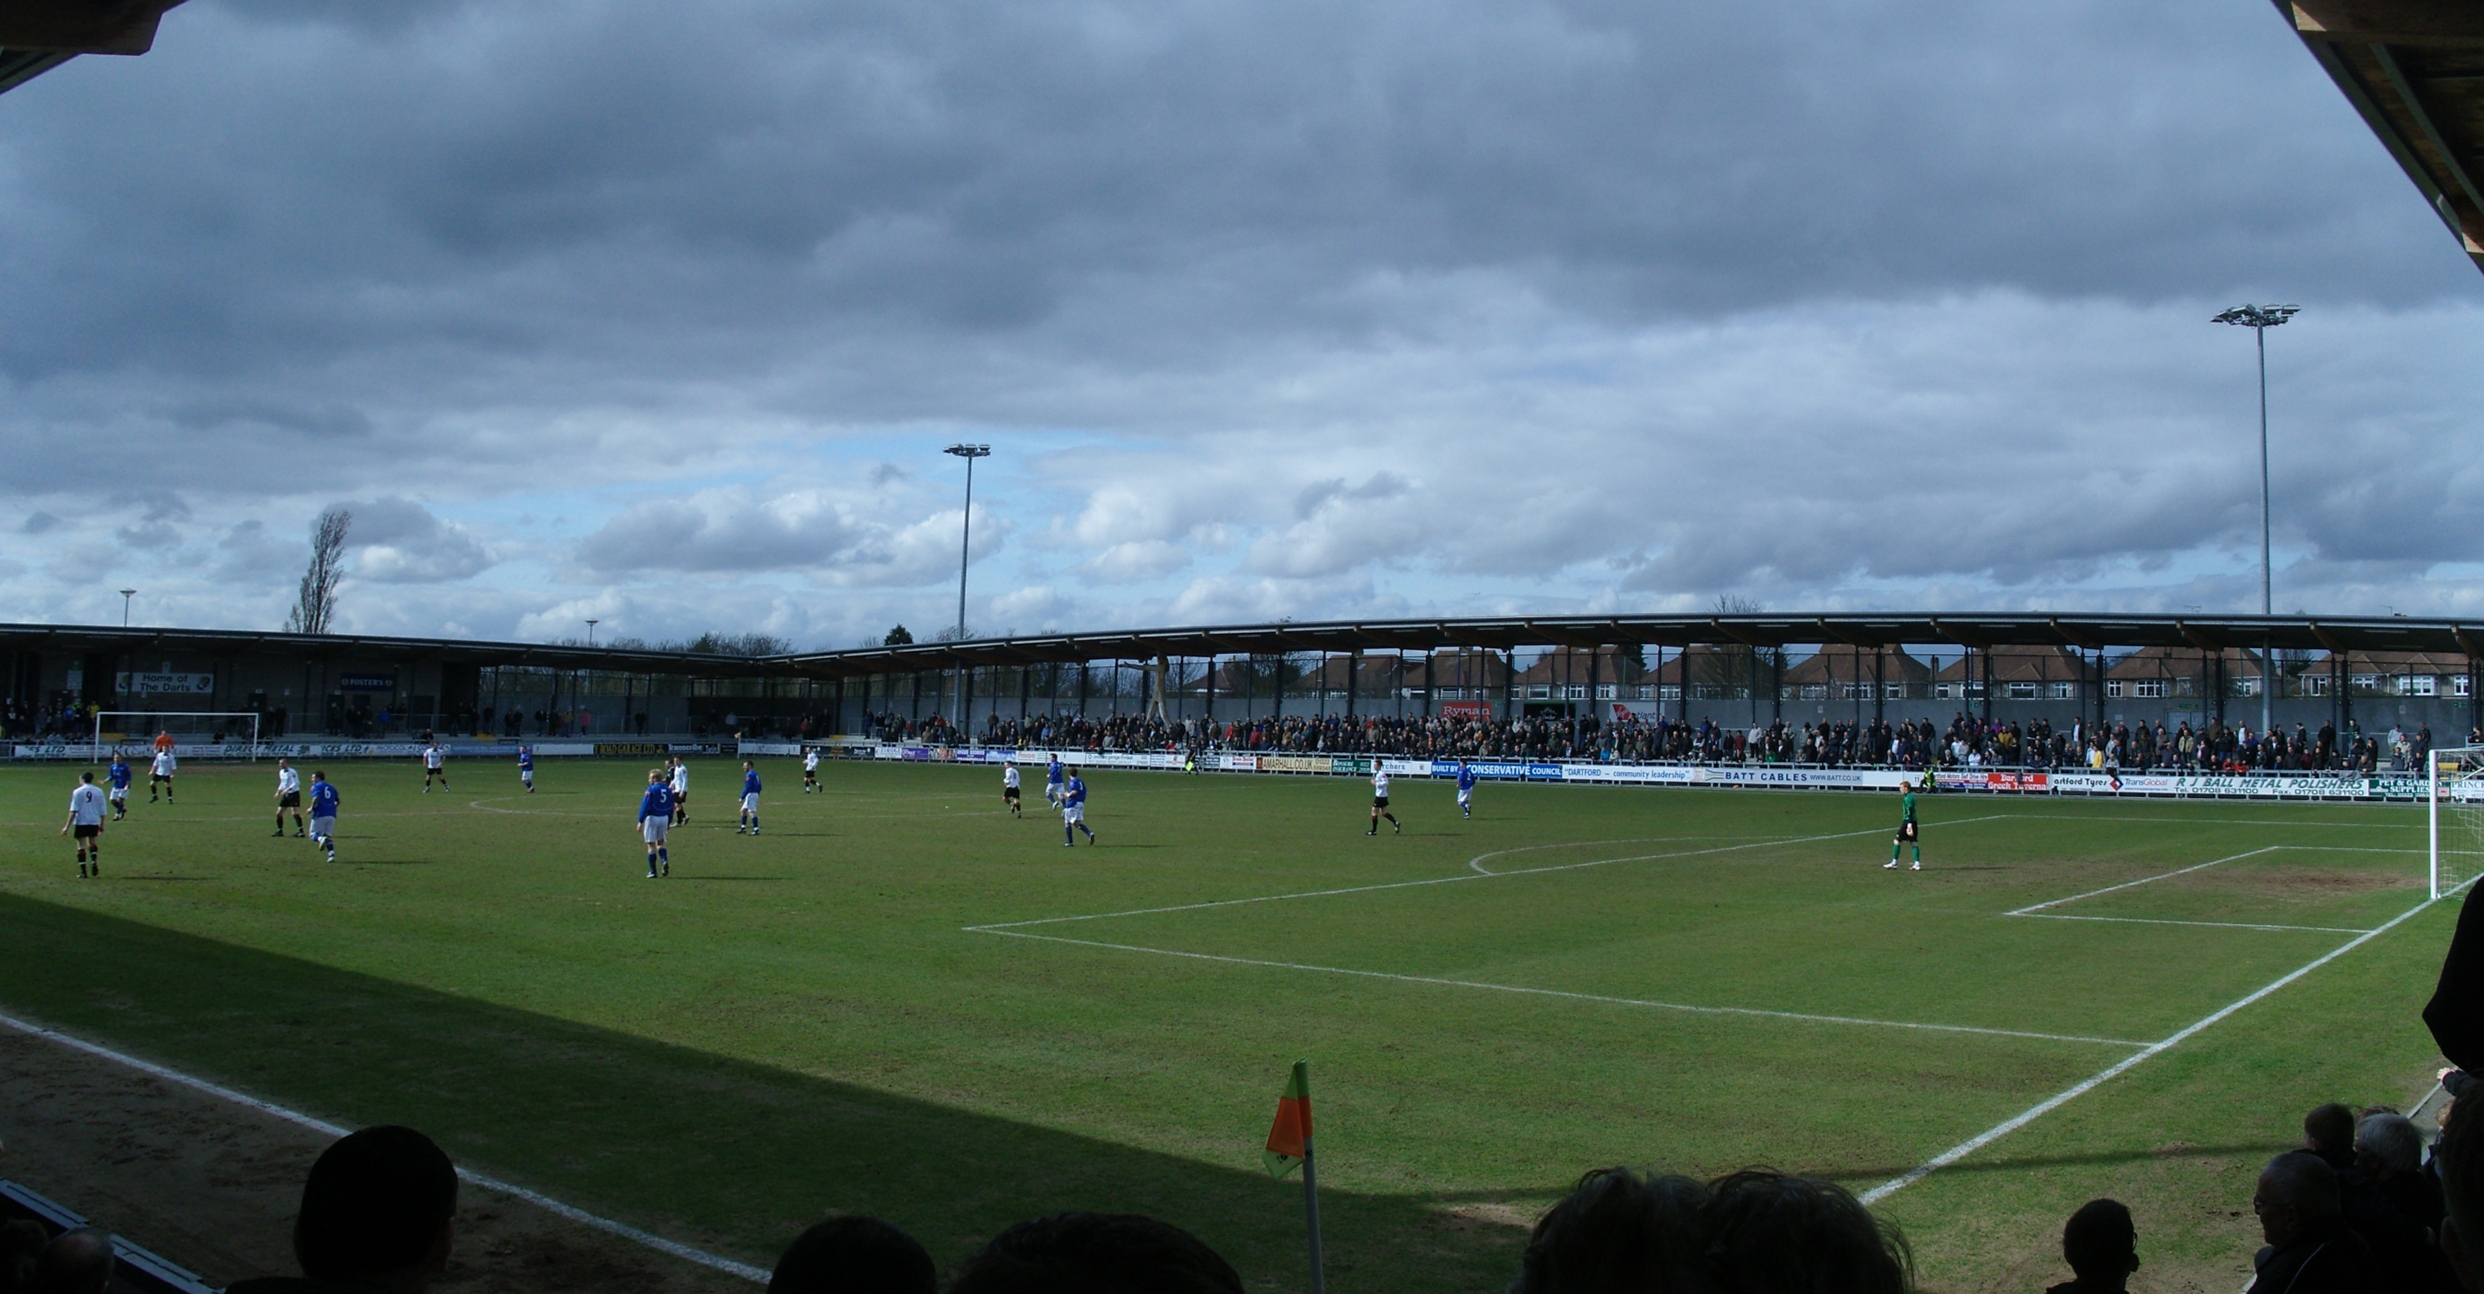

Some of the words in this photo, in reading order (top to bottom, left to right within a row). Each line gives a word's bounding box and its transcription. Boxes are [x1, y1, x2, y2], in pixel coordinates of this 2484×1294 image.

[143, 674, 173, 682] Home
[177, 674, 188, 682] of
[350, 678, 384, 686] FOSTER'S
[140, 683, 158, 691] The
[162, 683, 191, 692] Darts
[1443, 706, 1490, 716] Ryman
[1432, 764, 1450, 773] BUILT
[1450, 764, 1459, 773] BY
[1466, 764, 1531, 775] CONSERVATIVE
[1532, 767, 1561, 776] COUNCIL
[1613, 769, 1650, 779] community
[1725, 771, 1755, 780] BATT
[1760, 772, 1808, 781] CABLES
[1810, 774, 1862, 782] WWW.BATT.CO.UK
[2001, 774, 2034, 782] Darord
[1988, 781, 2011, 790] Greek
[2085, 778, 2107, 787] Tyres
[2124, 778, 2168, 786] TransGlobal
[2175, 778, 2186, 787] R
[2190, 778, 2198, 787] J
[2203, 778, 2234, 788] BALL
[2240, 779, 2282, 788] METAL
[2288, 779, 2364, 789] POLISHERS
[86, 791, 93, 803] 9
[324, 786, 331, 799] 6
[660, 789, 667, 803] 5
